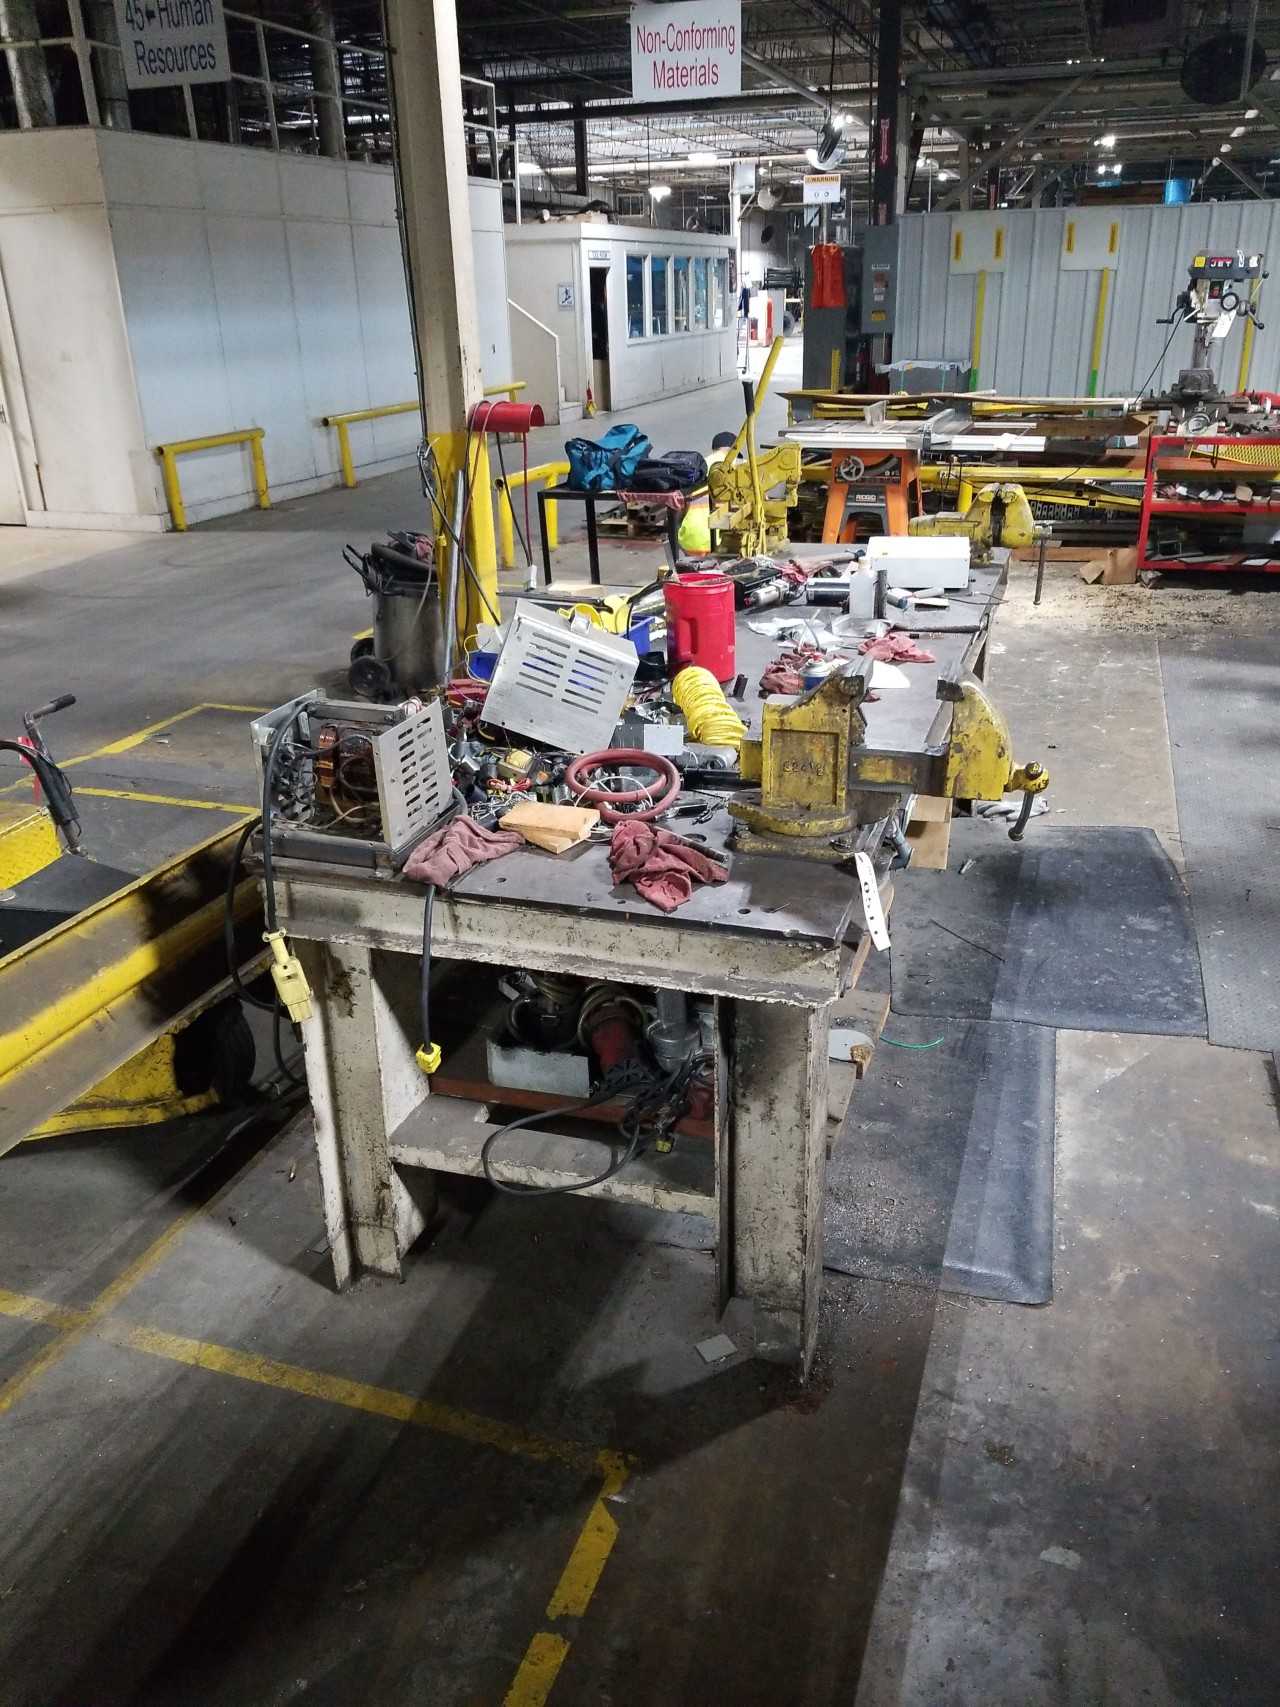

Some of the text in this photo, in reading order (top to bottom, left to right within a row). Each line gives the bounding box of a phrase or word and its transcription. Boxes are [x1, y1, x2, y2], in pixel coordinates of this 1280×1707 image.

[158, 0, 214, 29] Human
[637, 19, 735, 55] Non-Conforming
[134, 40, 216, 75] Resources
[653, 57, 719, 88] Materials
[1210, 257, 1233, 268] JET
